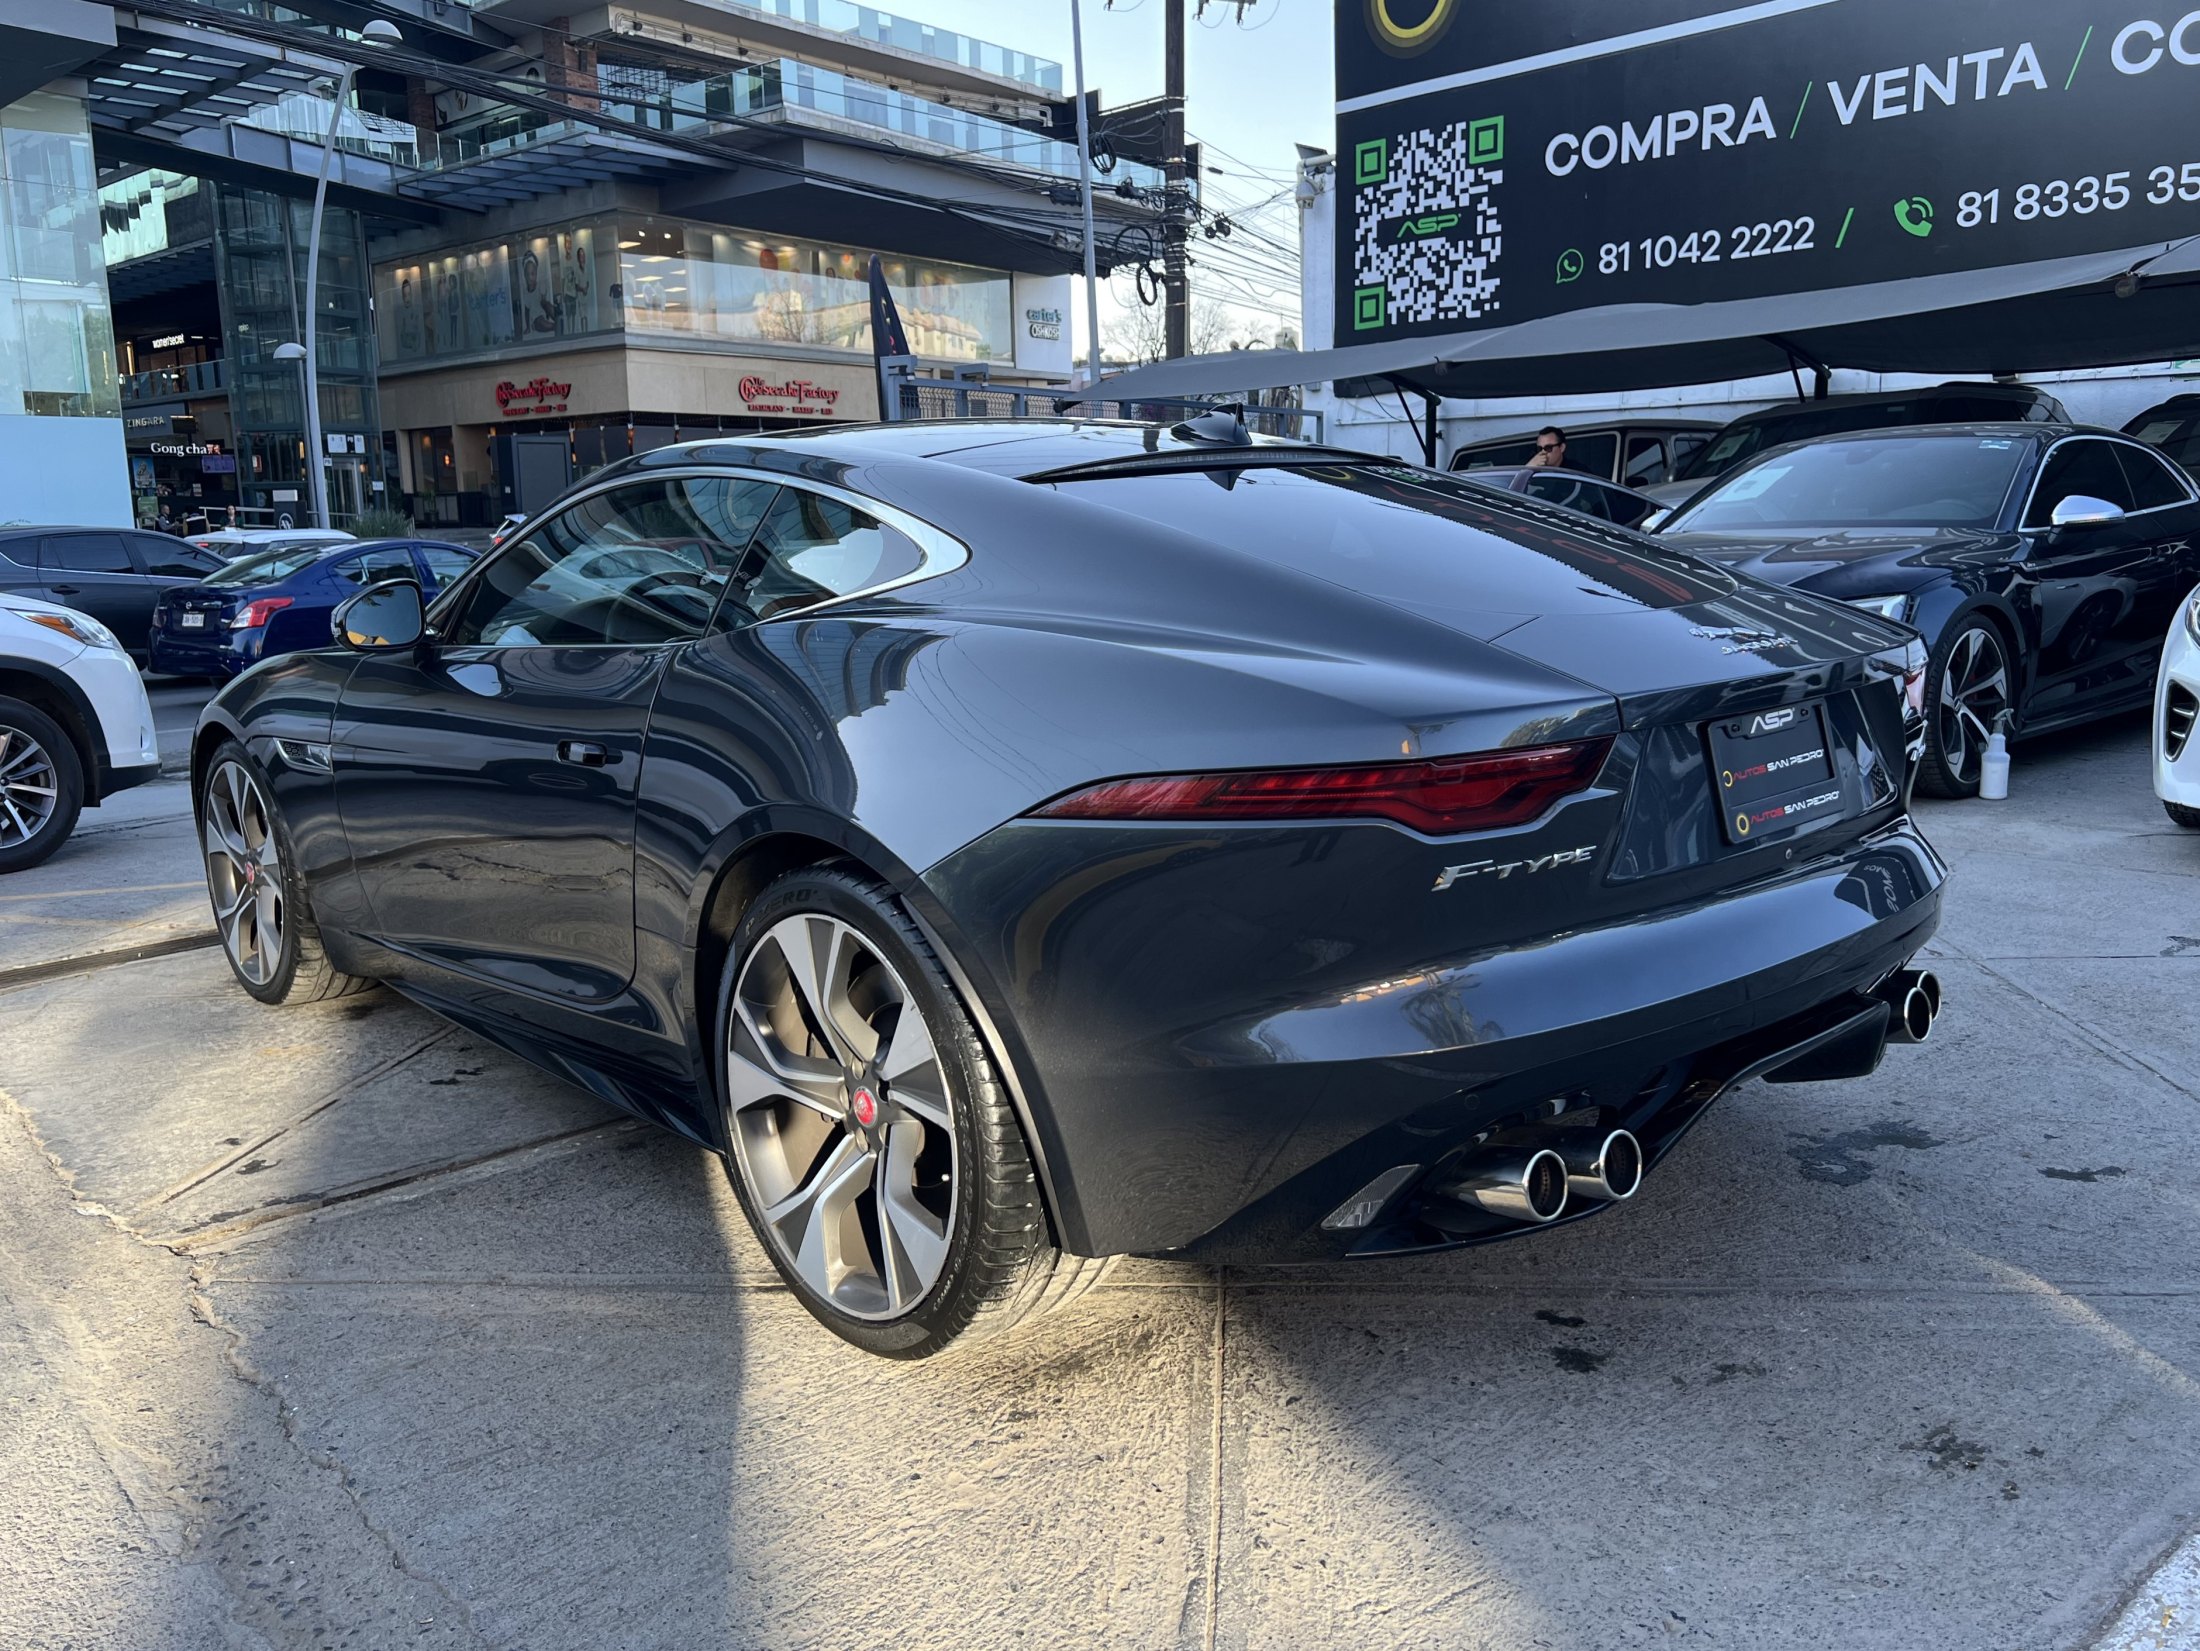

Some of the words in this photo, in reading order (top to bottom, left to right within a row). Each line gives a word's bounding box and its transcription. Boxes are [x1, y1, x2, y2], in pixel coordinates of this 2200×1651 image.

[1545, 96, 1777, 177] COMPRA
[1826, 41, 2048, 126] VENTA
[1598, 241, 1631, 275] 81
[1639, 229, 1722, 270] 1042
[1730, 215, 1815, 260] 2222
[1956, 188, 2000, 228] 81
[2013, 171, 2131, 221] 8335
[738, 375, 800, 403] Cheesecake
[792, 379, 840, 405] Factory
[126, 415, 165, 428] ZINGARA
[150, 442, 184, 457] Gong
[186, 442, 208, 455] cha
[1750, 708, 1795, 734] ASP
[1733, 764, 1767, 781] AUTOS
[1766, 758, 1790, 772] SAN
[1789, 748, 1824, 766] PEDRO
[1750, 807, 1785, 824] AUTOS
[1784, 800, 1807, 815] SAN
[1806, 790, 1839, 807] PEDRO
[1430, 845, 1597, 892] F-TYPE
